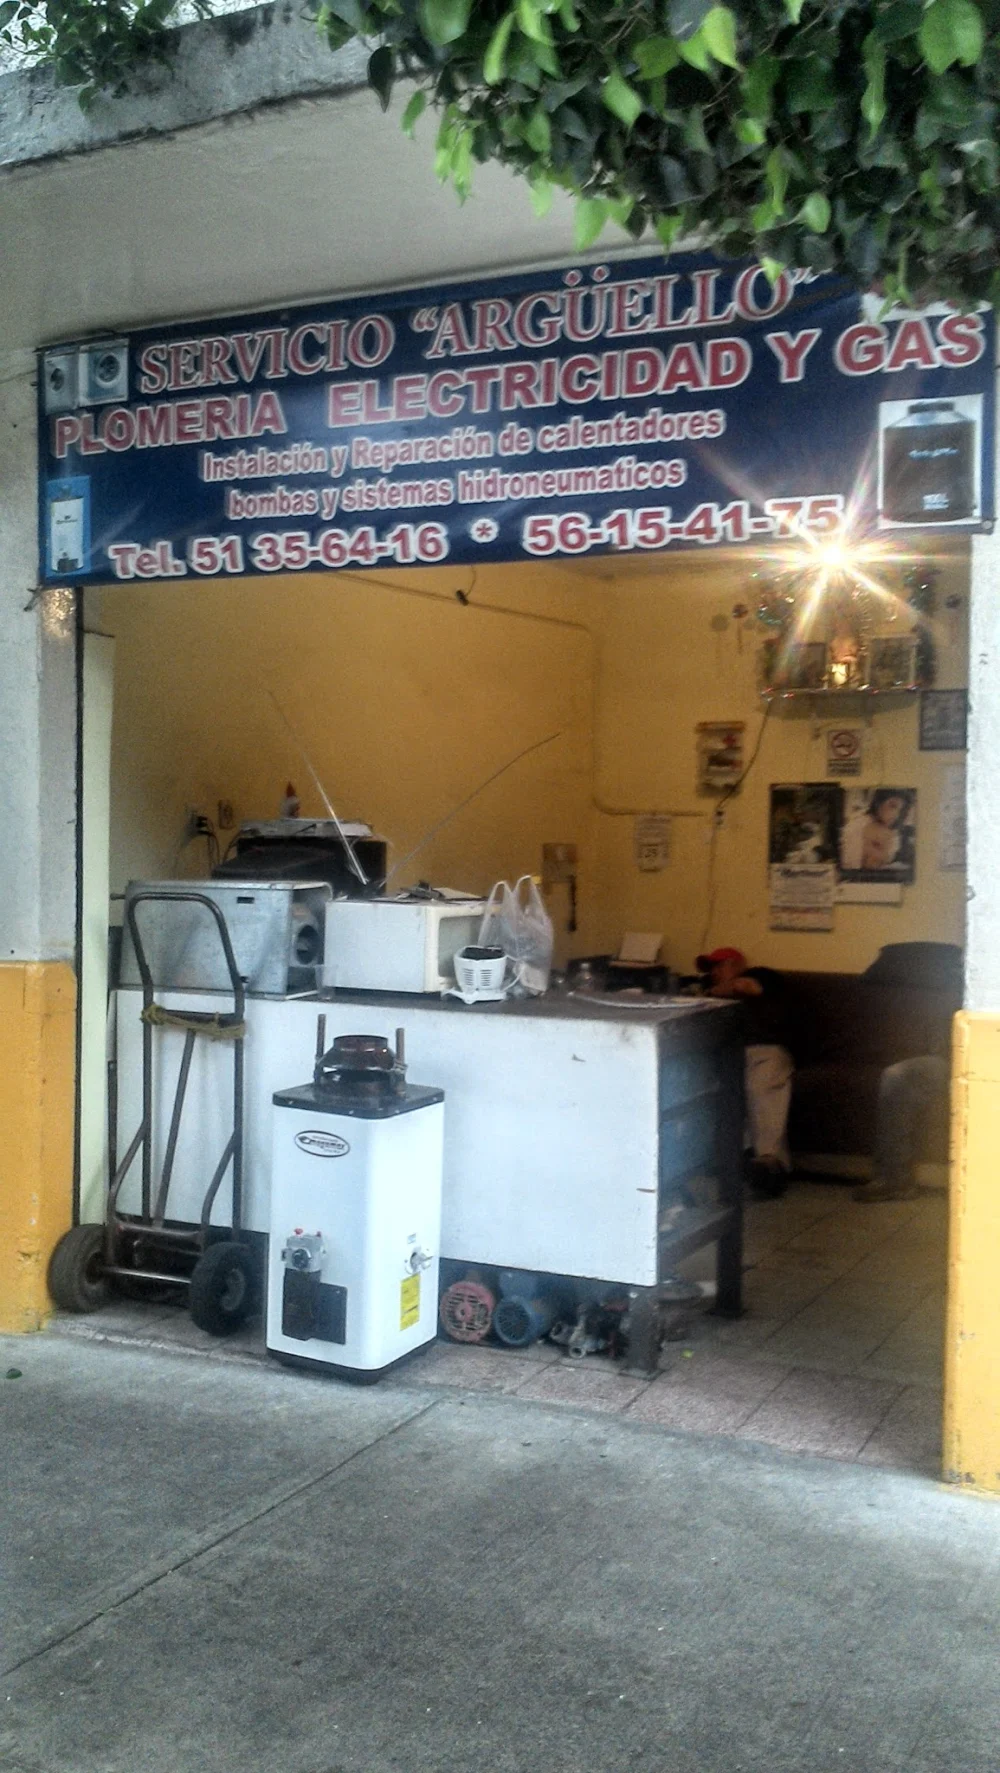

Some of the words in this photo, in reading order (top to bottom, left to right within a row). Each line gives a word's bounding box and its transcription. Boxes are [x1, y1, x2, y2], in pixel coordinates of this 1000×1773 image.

[55, 391, 288, 458] PLOMERIA
[328, 337, 751, 428] ELECTRICIDAD
[766, 327, 821, 383] Y
[834, 313, 985, 376] GAS
[138, 314, 395, 394] SERVICIO
[203, 441, 327, 482] Instalación
[331, 446, 348, 478] y
[352, 425, 492, 473] Reparación
[499, 424, 533, 457] de
[538, 405, 726, 453] calentadores
[227, 485, 318, 521] bombas
[321, 489, 341, 520] y
[342, 475, 453, 512] sistemas
[457, 457, 686, 504] hidroneumaticos
[109, 540, 187, 580] Tel.
[192, 534, 244, 573] 51
[252, 522, 448, 571] 35-64-16
[523, 494, 845, 556] 56-15-41-75
